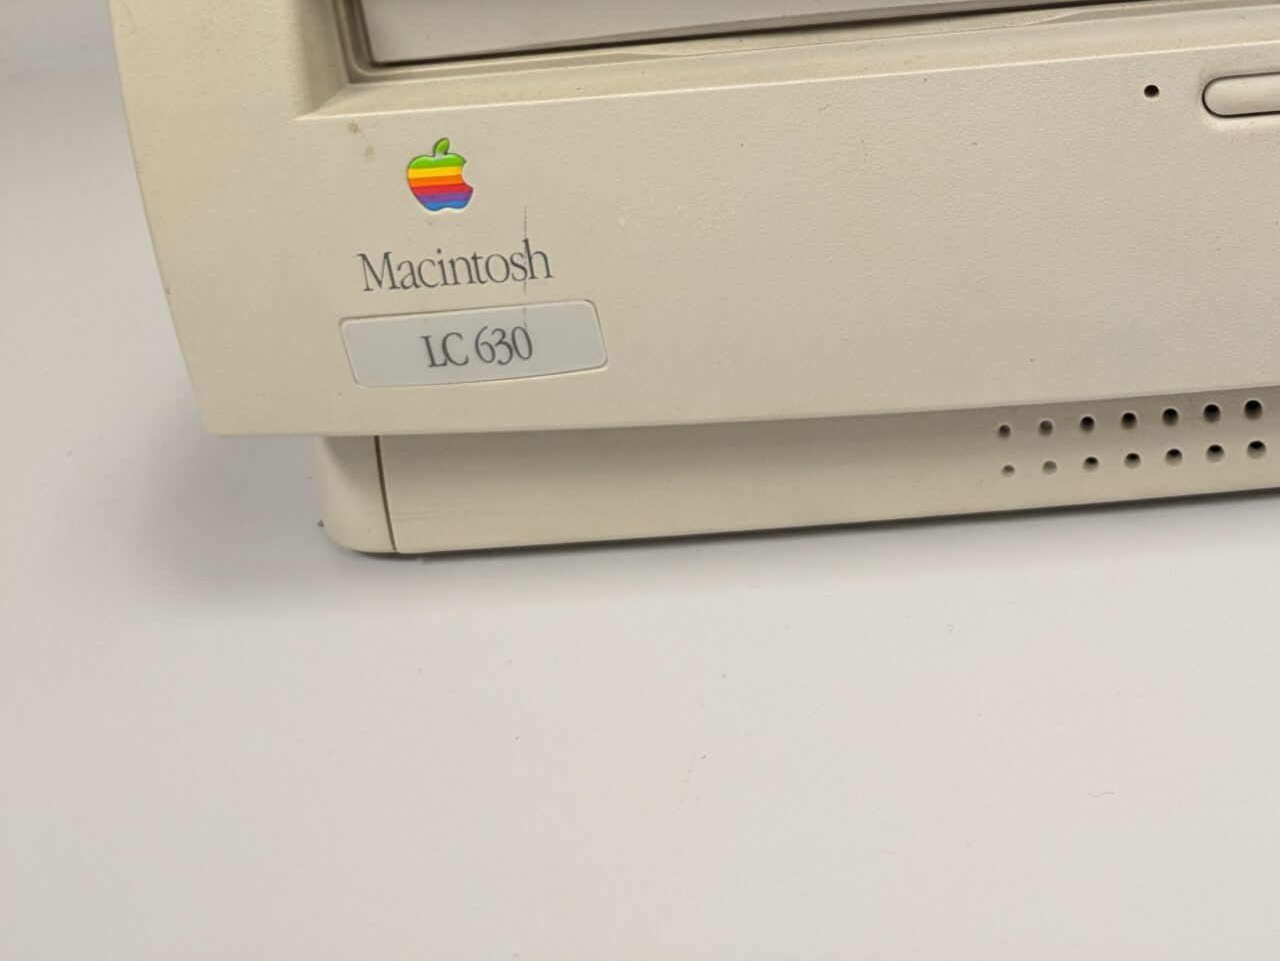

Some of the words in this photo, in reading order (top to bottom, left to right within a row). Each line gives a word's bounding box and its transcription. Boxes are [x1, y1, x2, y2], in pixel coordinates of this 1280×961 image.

[357, 238, 555, 292] Macintosh
[420, 331, 470, 368] LC
[474, 325, 534, 366] 630
